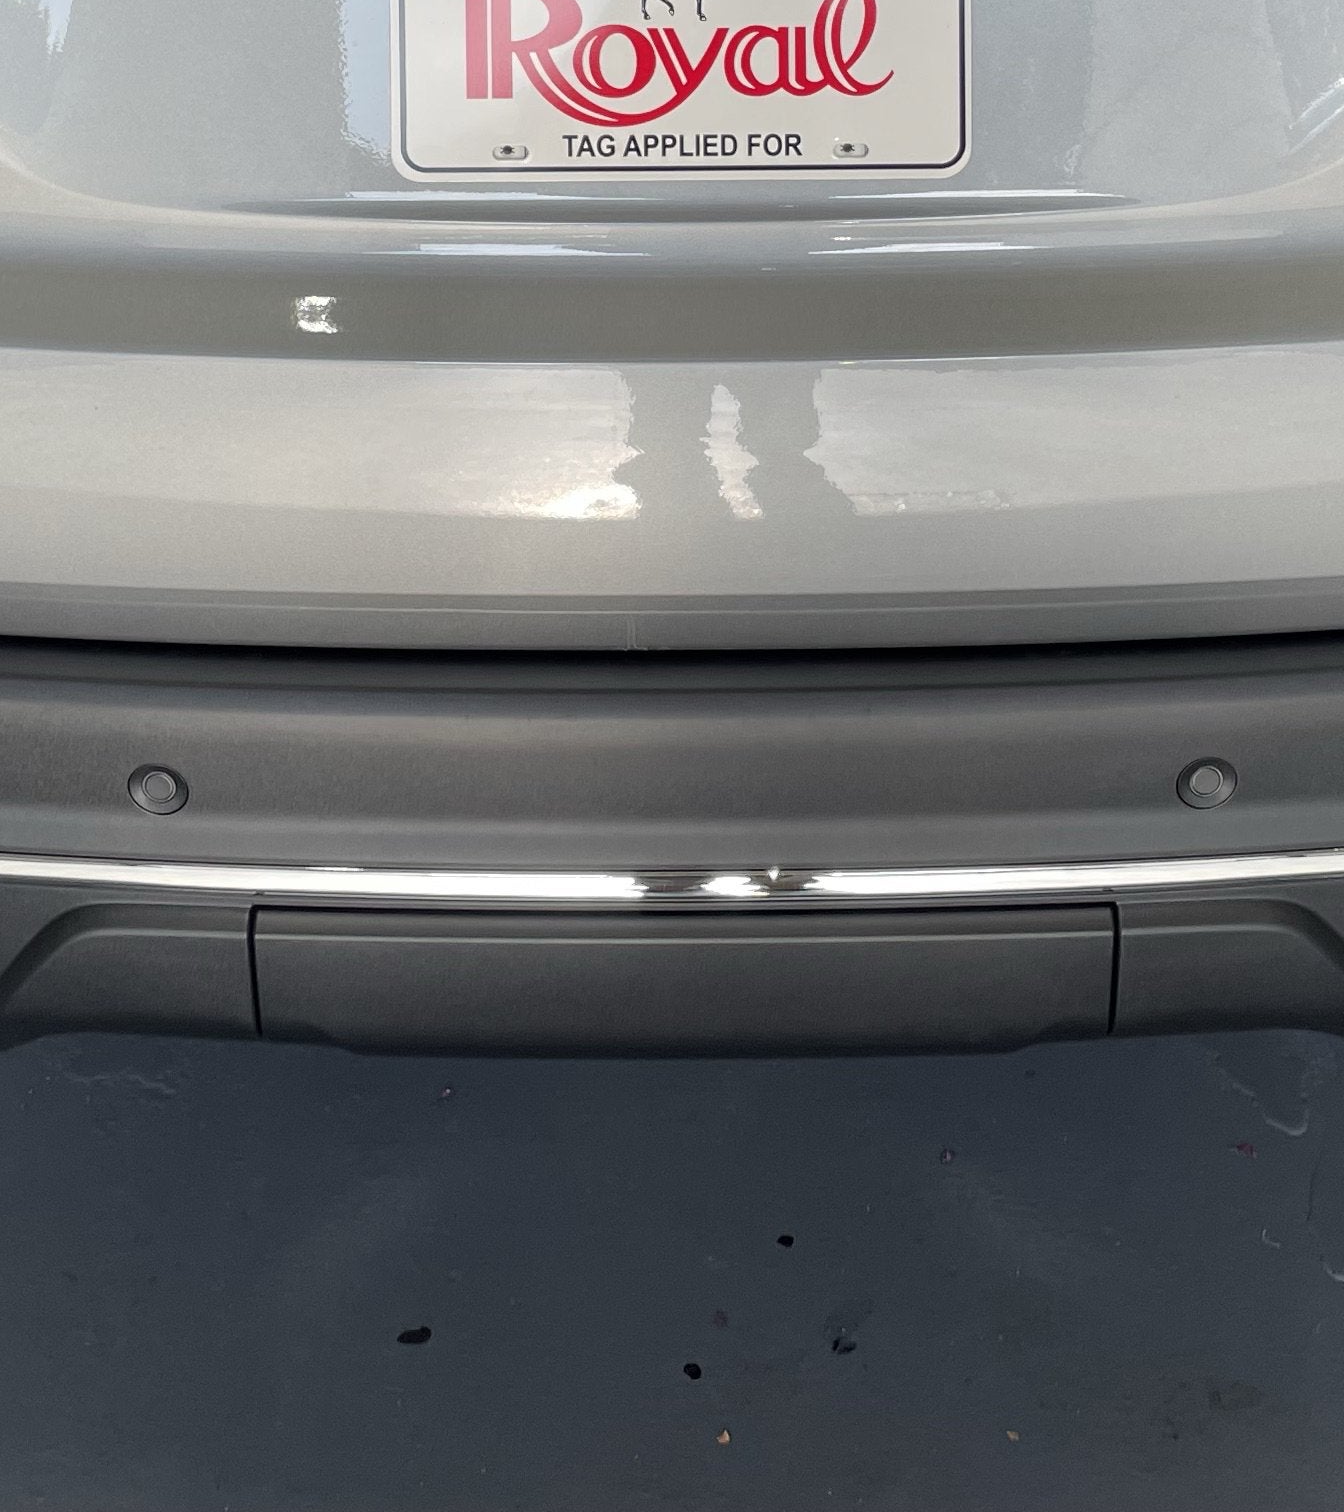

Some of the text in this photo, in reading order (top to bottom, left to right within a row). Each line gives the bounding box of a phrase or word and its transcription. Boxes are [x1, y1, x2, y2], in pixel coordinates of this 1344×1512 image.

[562, 133, 803, 157] TAG APPLIED FOR
